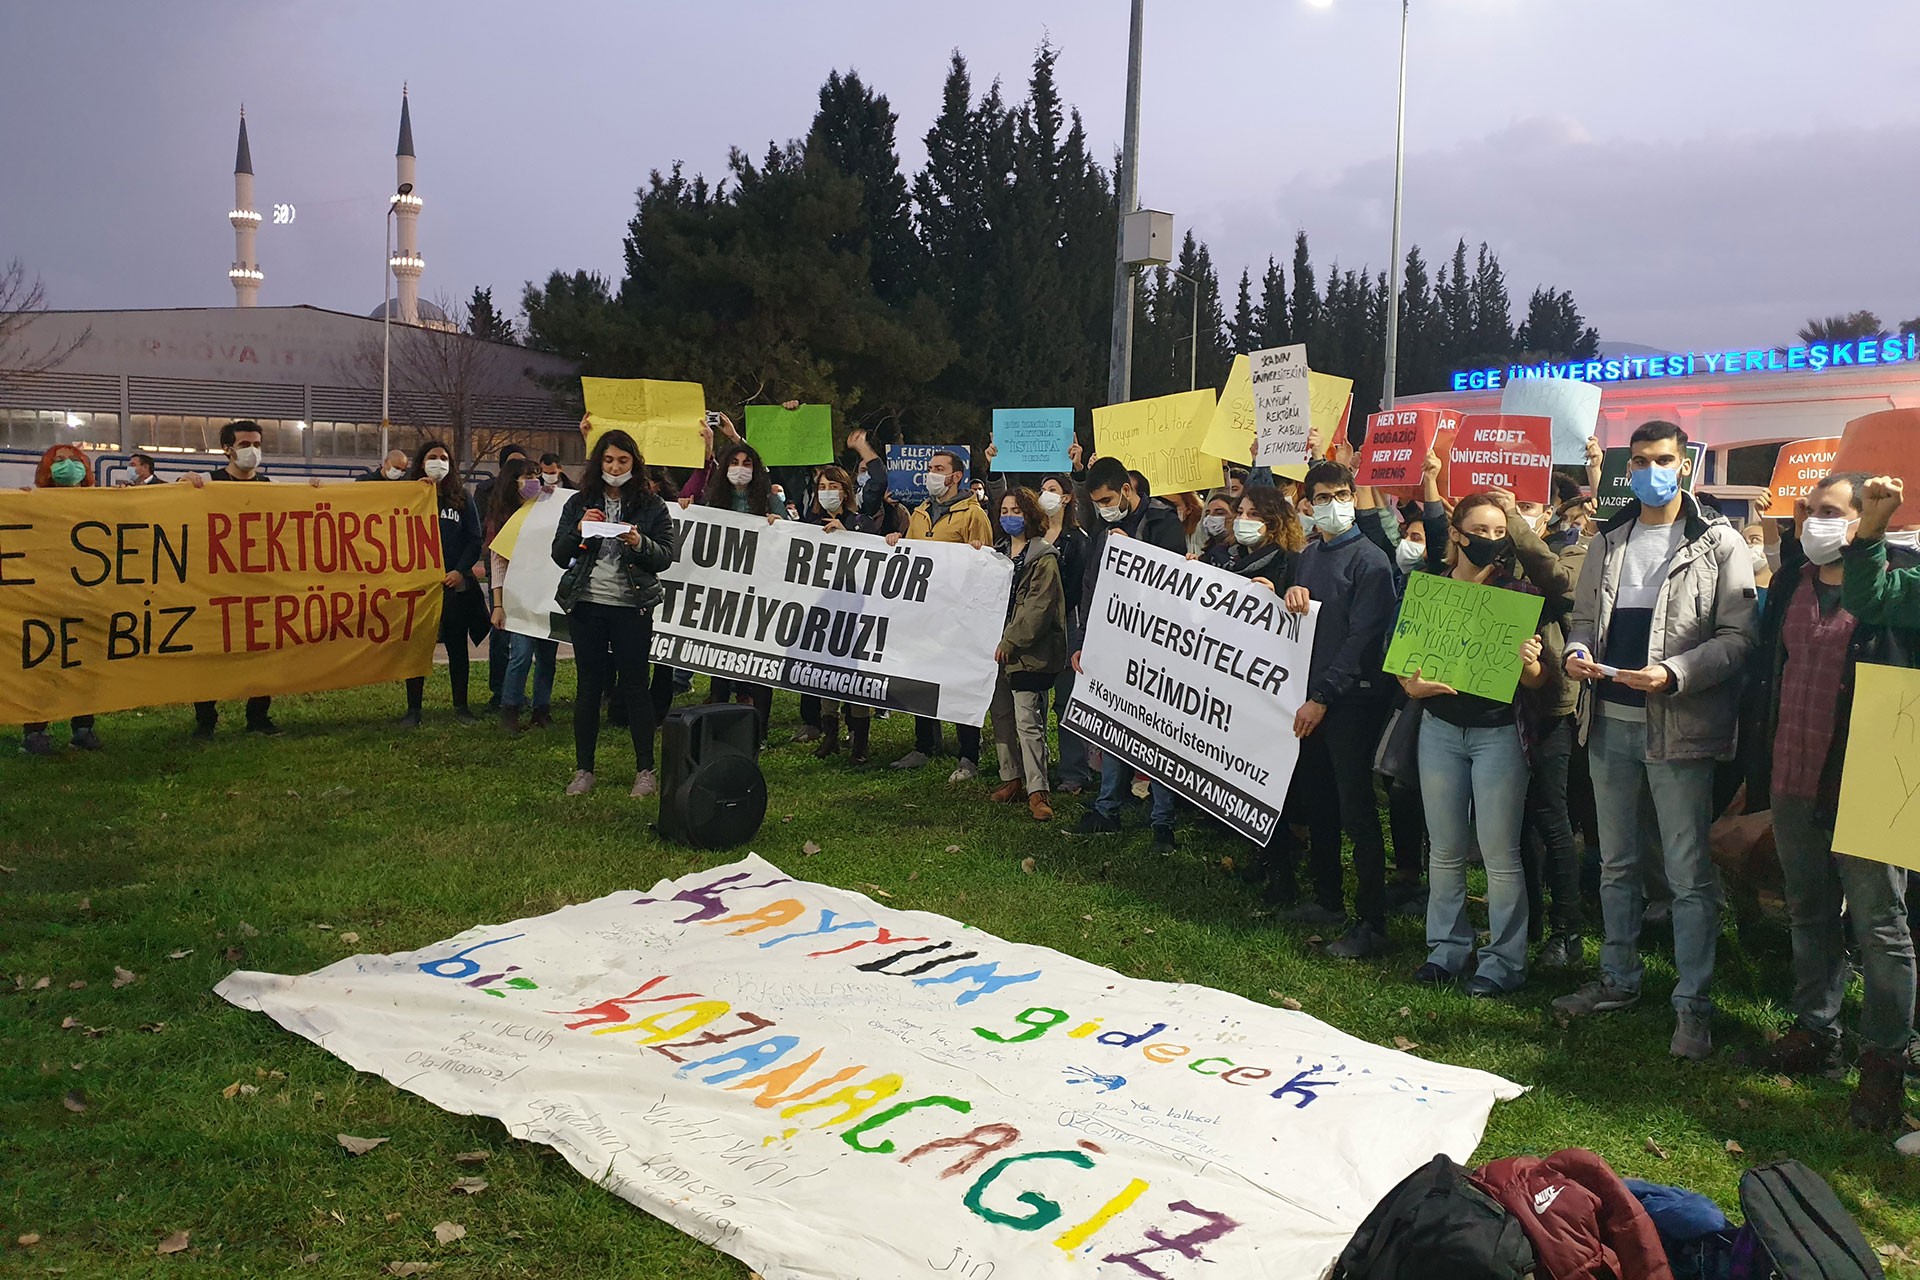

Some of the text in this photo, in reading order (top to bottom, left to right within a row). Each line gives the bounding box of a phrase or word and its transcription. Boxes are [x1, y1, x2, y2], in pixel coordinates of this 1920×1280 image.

[1453, 333, 1916, 391] EGE ÜNİVERSİTESİ YERLEŞKESİ
[1099, 403, 1193, 447] Kayyum Rektöre
[1373, 428, 1416, 445] BOĞAZİÇİ
[1376, 411, 1417, 427] HER YER
[1474, 429, 1525, 443] NECDET
[1160, 447, 1201, 485] YUH
[1372, 449, 1412, 463] HER YER
[1451, 447, 1550, 468] ÜNİVERSİTEDEN
[1472, 472, 1517, 487] DEFOL!
[1778, 484, 1797, 497] BİZ
[70, 521, 189, 587] SEN
[207, 502, 442, 574] REKTÖRSÜN
[784, 537, 935, 603] REKTÖR
[1105, 546, 1203, 602] FERMAN
[1413, 574, 1494, 618] ÖZGÜR
[22, 584, 426, 669] DE BİZ TERÖRİST
[660, 579, 890, 664] TEMİYORUZ!
[1402, 599, 1519, 646] ÜNİVERSİTE
[1106, 595, 1290, 697] ÜNİVERSİTELER
[680, 640, 787, 682] ÜNİVERSİTESİ
[788, 659, 891, 701] ÖĞRENCİLERİ
[1125, 657, 1233, 734] BİZİMDİR!
[1088, 678, 1270, 787] #KayyumRektörİstemiyoruz
[1067, 703, 1275, 836] İZMİR ÜNİVERSİTE DAYANIŞMASI
[1534, 1184, 1556, 1205] NIKE
